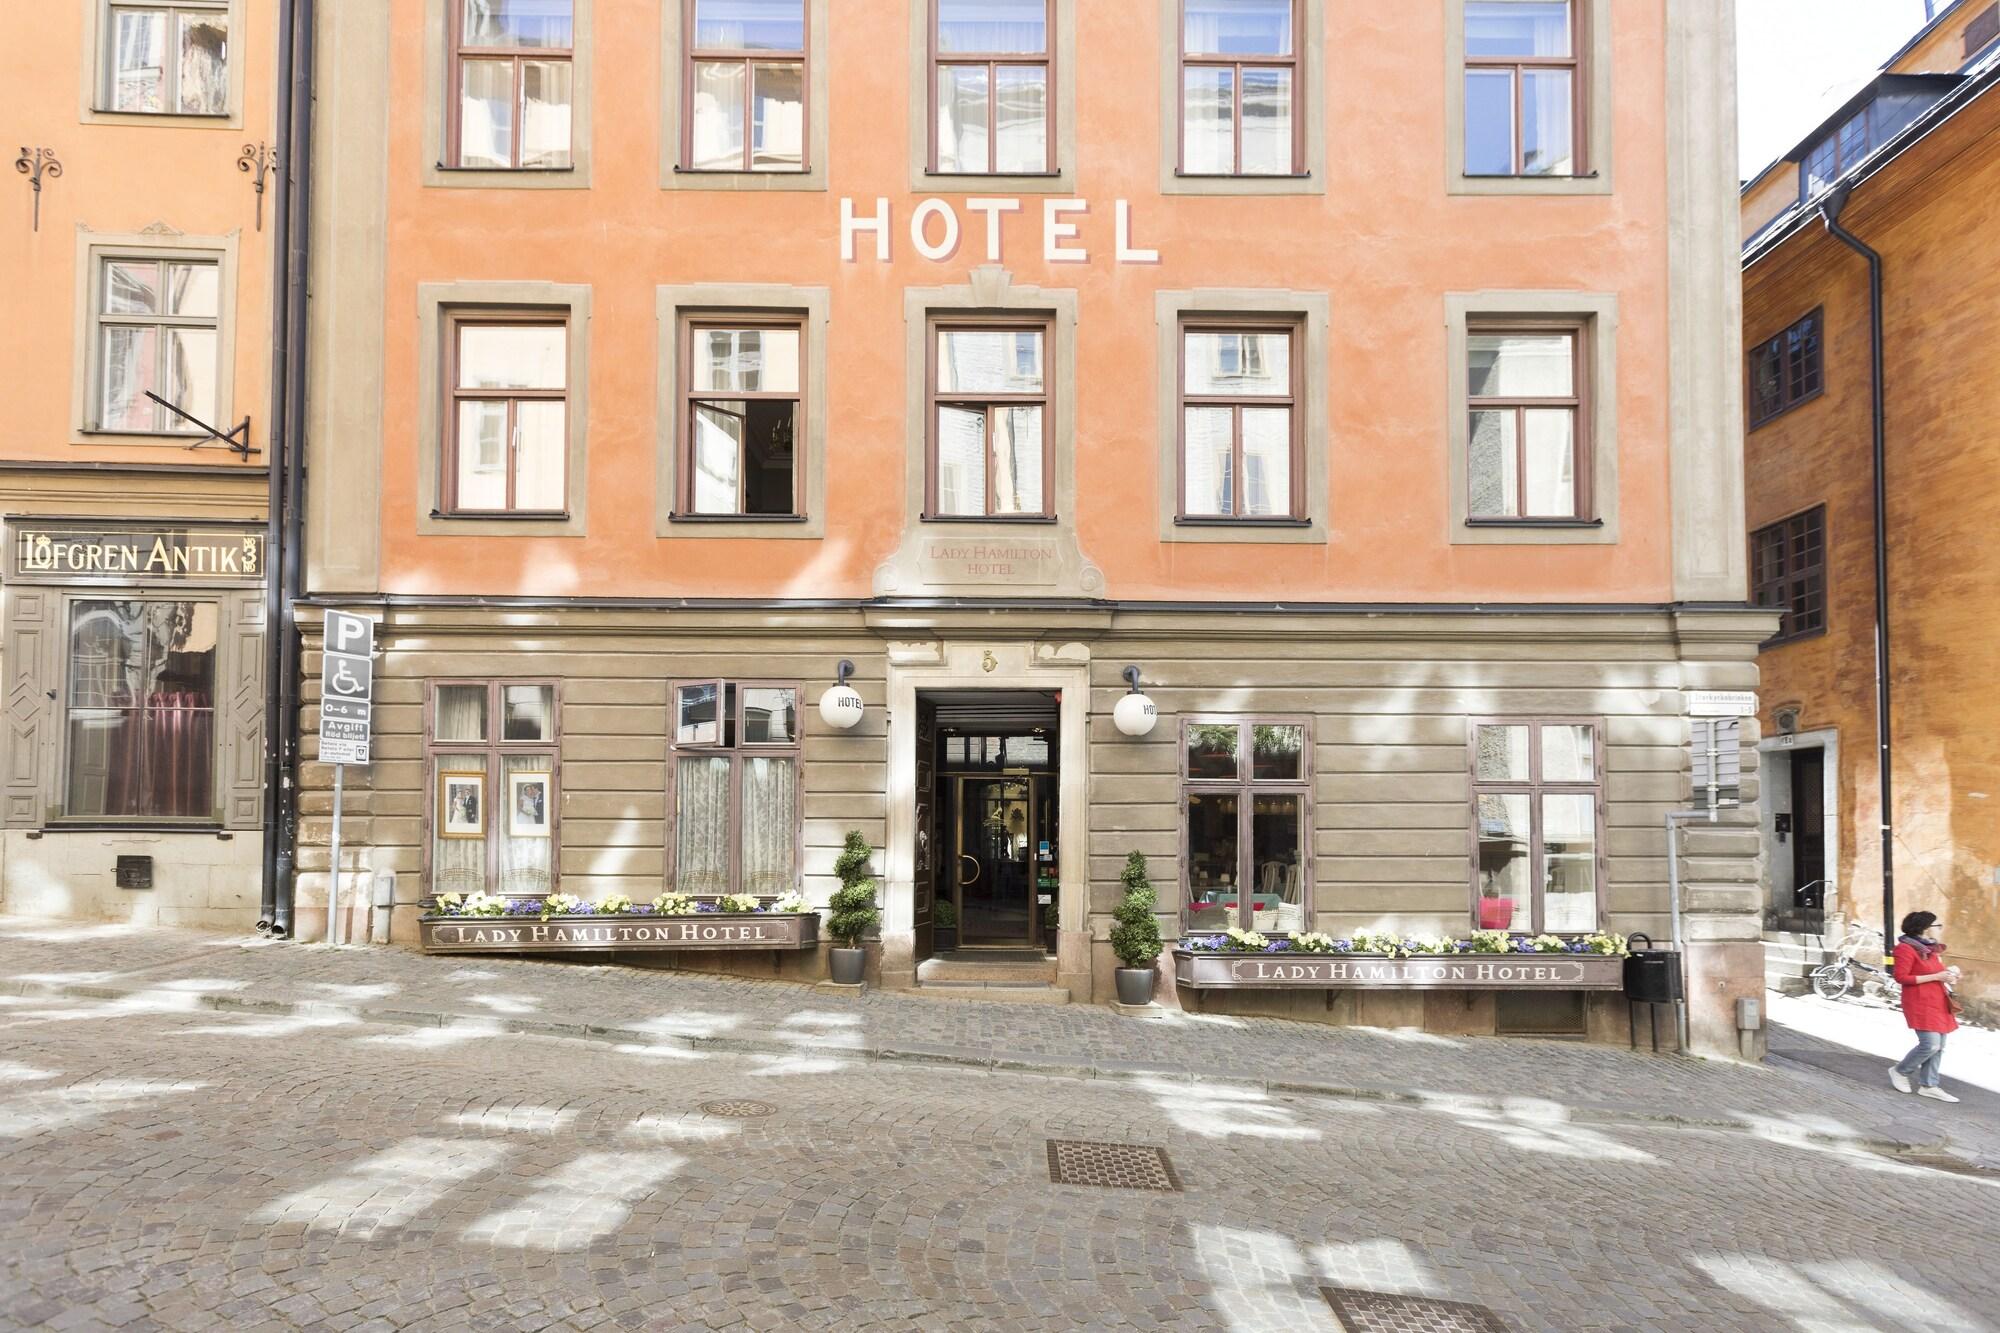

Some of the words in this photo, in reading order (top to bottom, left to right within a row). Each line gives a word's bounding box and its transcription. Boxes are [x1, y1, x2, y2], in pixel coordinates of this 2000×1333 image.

[841, 198, 1160, 264] HOTEL
[144, 537, 240, 573] ANTIK
[930, 546, 970, 560] LADY
[974, 546, 1053, 560] HAMILTON
[968, 564, 1016, 575] HOTEL
[337, 616, 365, 650] P
[983, 650, 998, 672] 5
[325, 704, 348, 714] 0-6
[328, 721, 364, 733] Avgift
[342, 732, 365, 742] biljett
[457, 927, 522, 943] LADY
[531, 925, 670, 941] HAMILTON
[680, 924, 766, 940] HOTEL
[1257, 963, 1321, 979] LADY
[1329, 963, 1466, 980] HAMILTON
[1476, 964, 1562, 980] HOTEL
